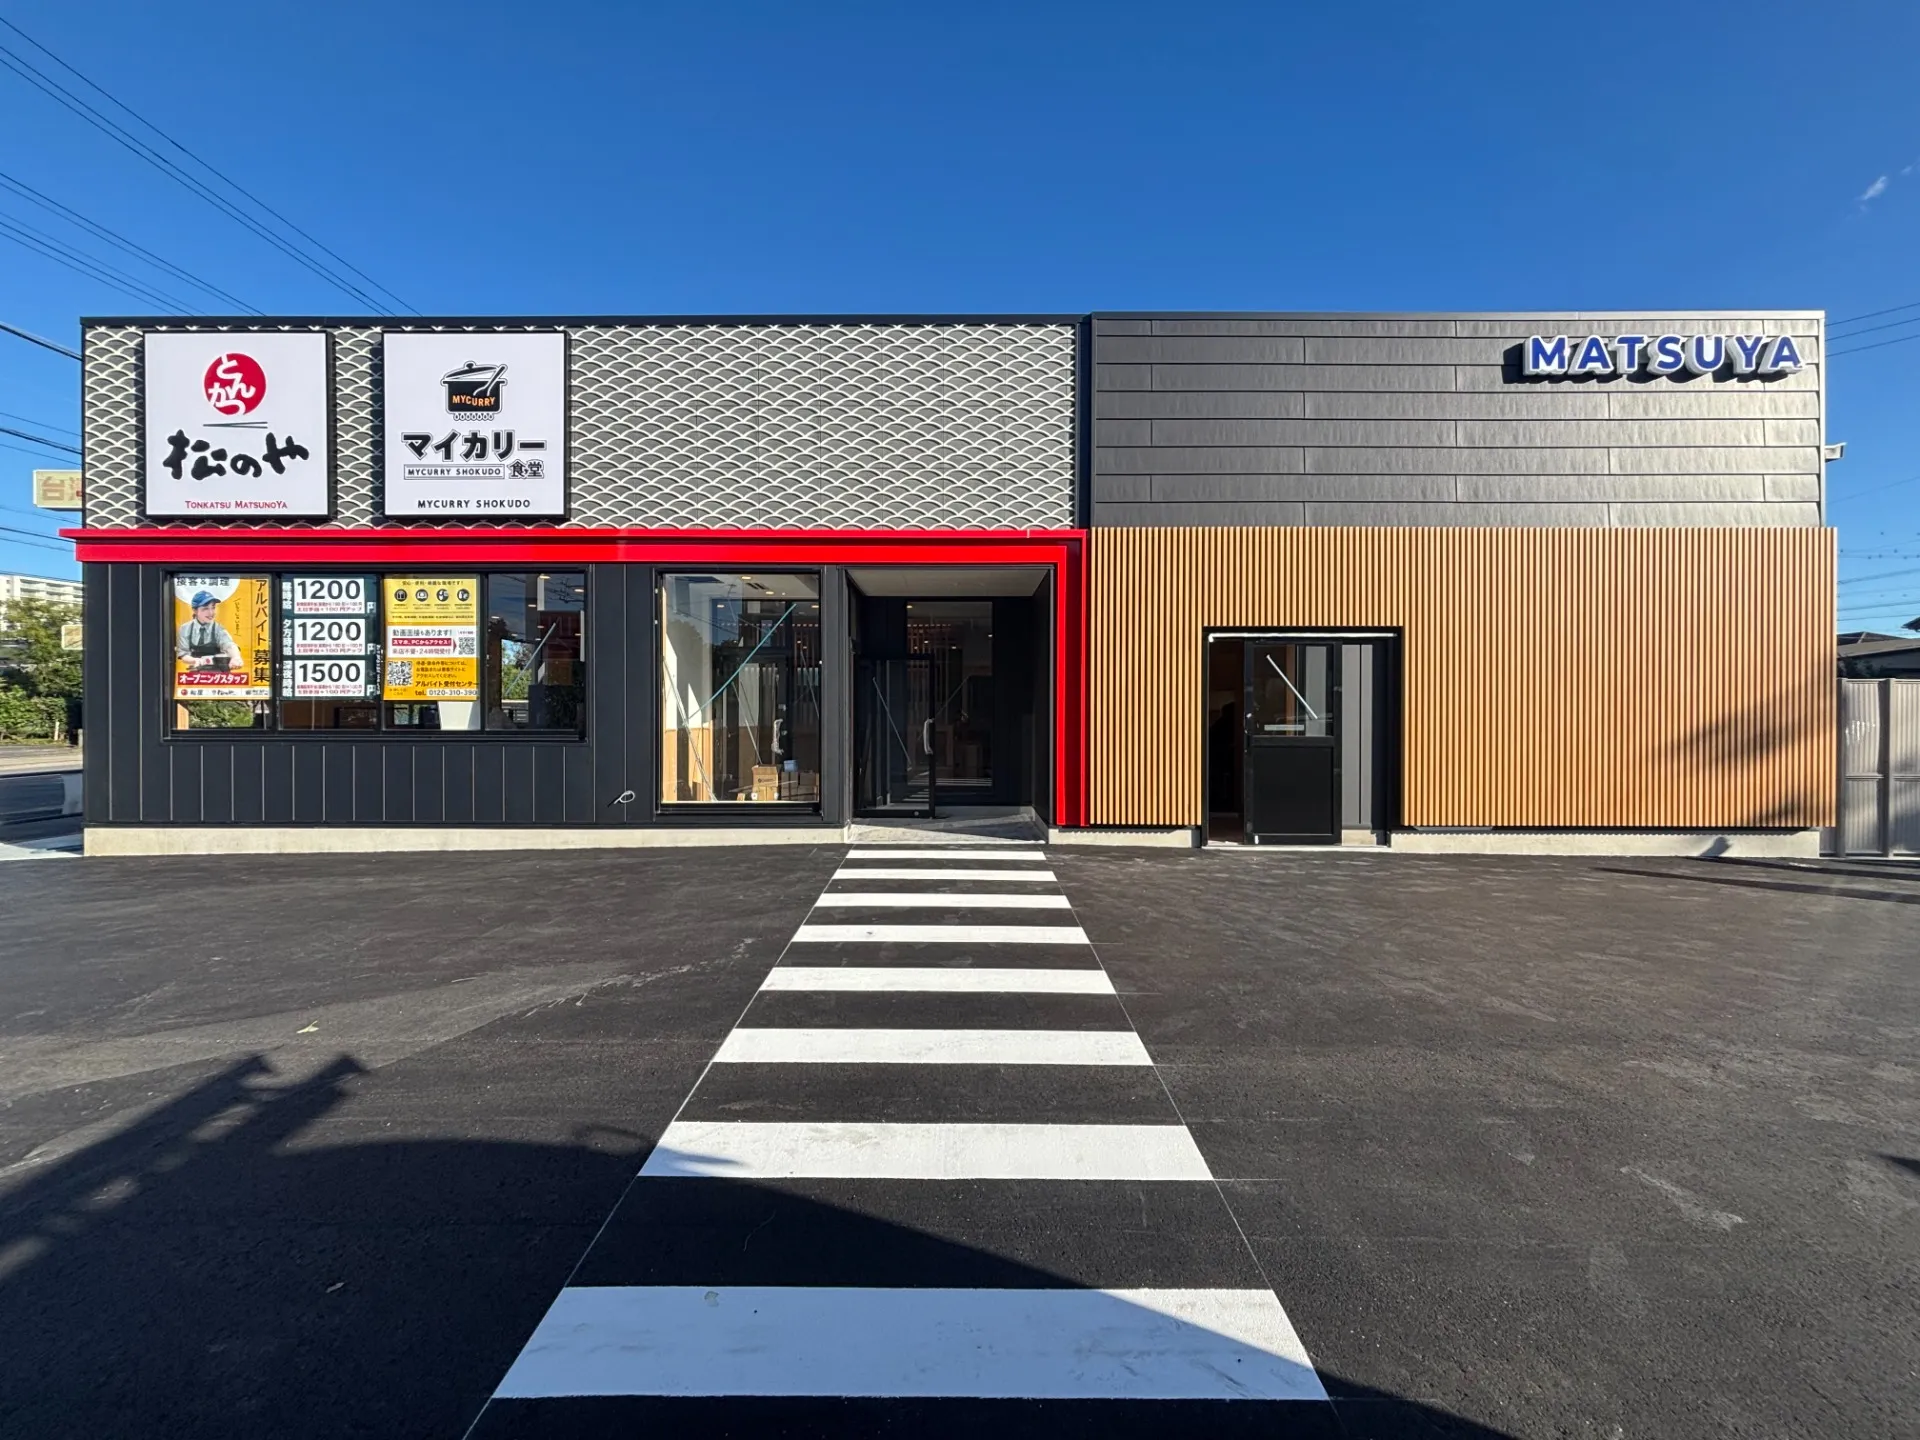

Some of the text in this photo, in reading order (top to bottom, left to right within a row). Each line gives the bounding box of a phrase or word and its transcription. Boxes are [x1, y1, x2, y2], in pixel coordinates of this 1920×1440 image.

[1526, 335, 1803, 372] MATSUYA
[207, 353, 256, 415] とんかつ
[452, 394, 496, 407] MYCURRY
[162, 429, 310, 481] 松のや
[401, 429, 547, 462] マイカリー
[407, 468, 501, 476] MYCURRY SHOKUDO
[509, 460, 544, 479] 食堂
[184, 501, 288, 509] TONKATSU MATSUNOYA
[417, 499, 531, 509] MYCURRY SHOKUDO
[297, 580, 361, 600] 1200
[366, 602, 377, 613] 円
[254, 580, 270, 683] アルバイト募集
[298, 621, 361, 641] 1200
[366, 643, 377, 655] 円
[179, 673, 248, 684] オープニングスタッフ
[299, 663, 361, 683] 1500
[366, 684, 377, 696] 円
